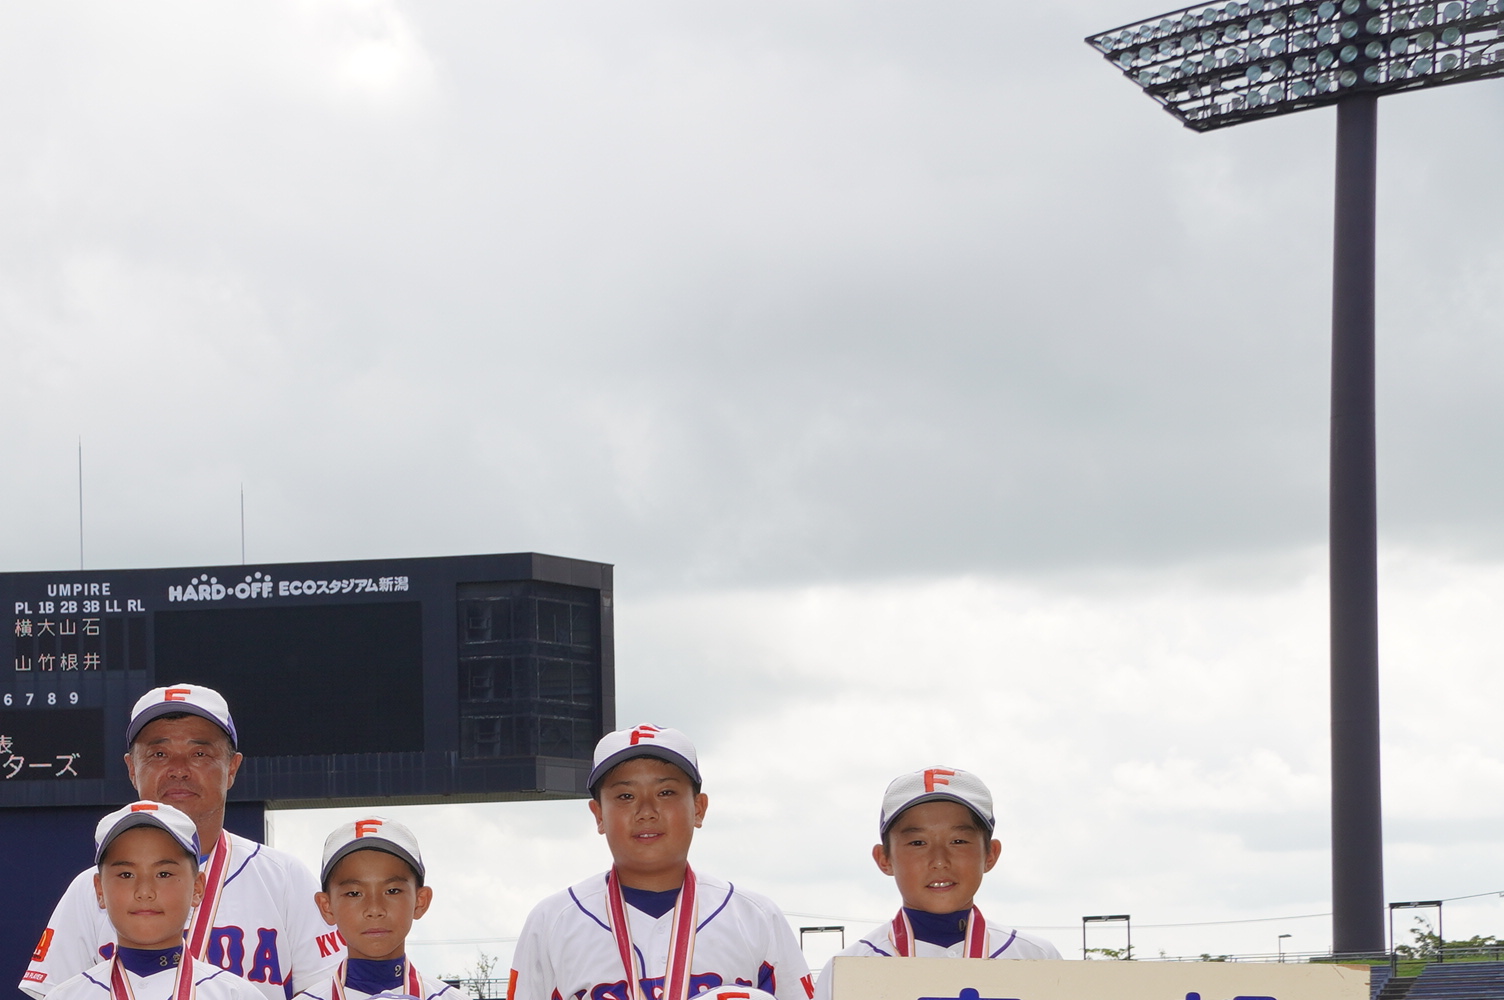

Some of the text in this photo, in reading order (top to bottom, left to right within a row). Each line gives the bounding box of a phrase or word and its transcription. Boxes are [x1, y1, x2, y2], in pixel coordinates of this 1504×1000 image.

[47, 582, 111, 597] UMPIRE
[14, 599, 146, 615] PL 1B 2B 3B LL RL
[3, 693, 13, 706] 6
[25, 693, 34, 705] 7
[47, 692, 57, 705] 8
[69, 692, 79, 704] 9
[164, 688, 191, 702] F
[629, 724, 661, 746] F
[923, 768, 955, 793] F
[355, 819, 383, 839] F
